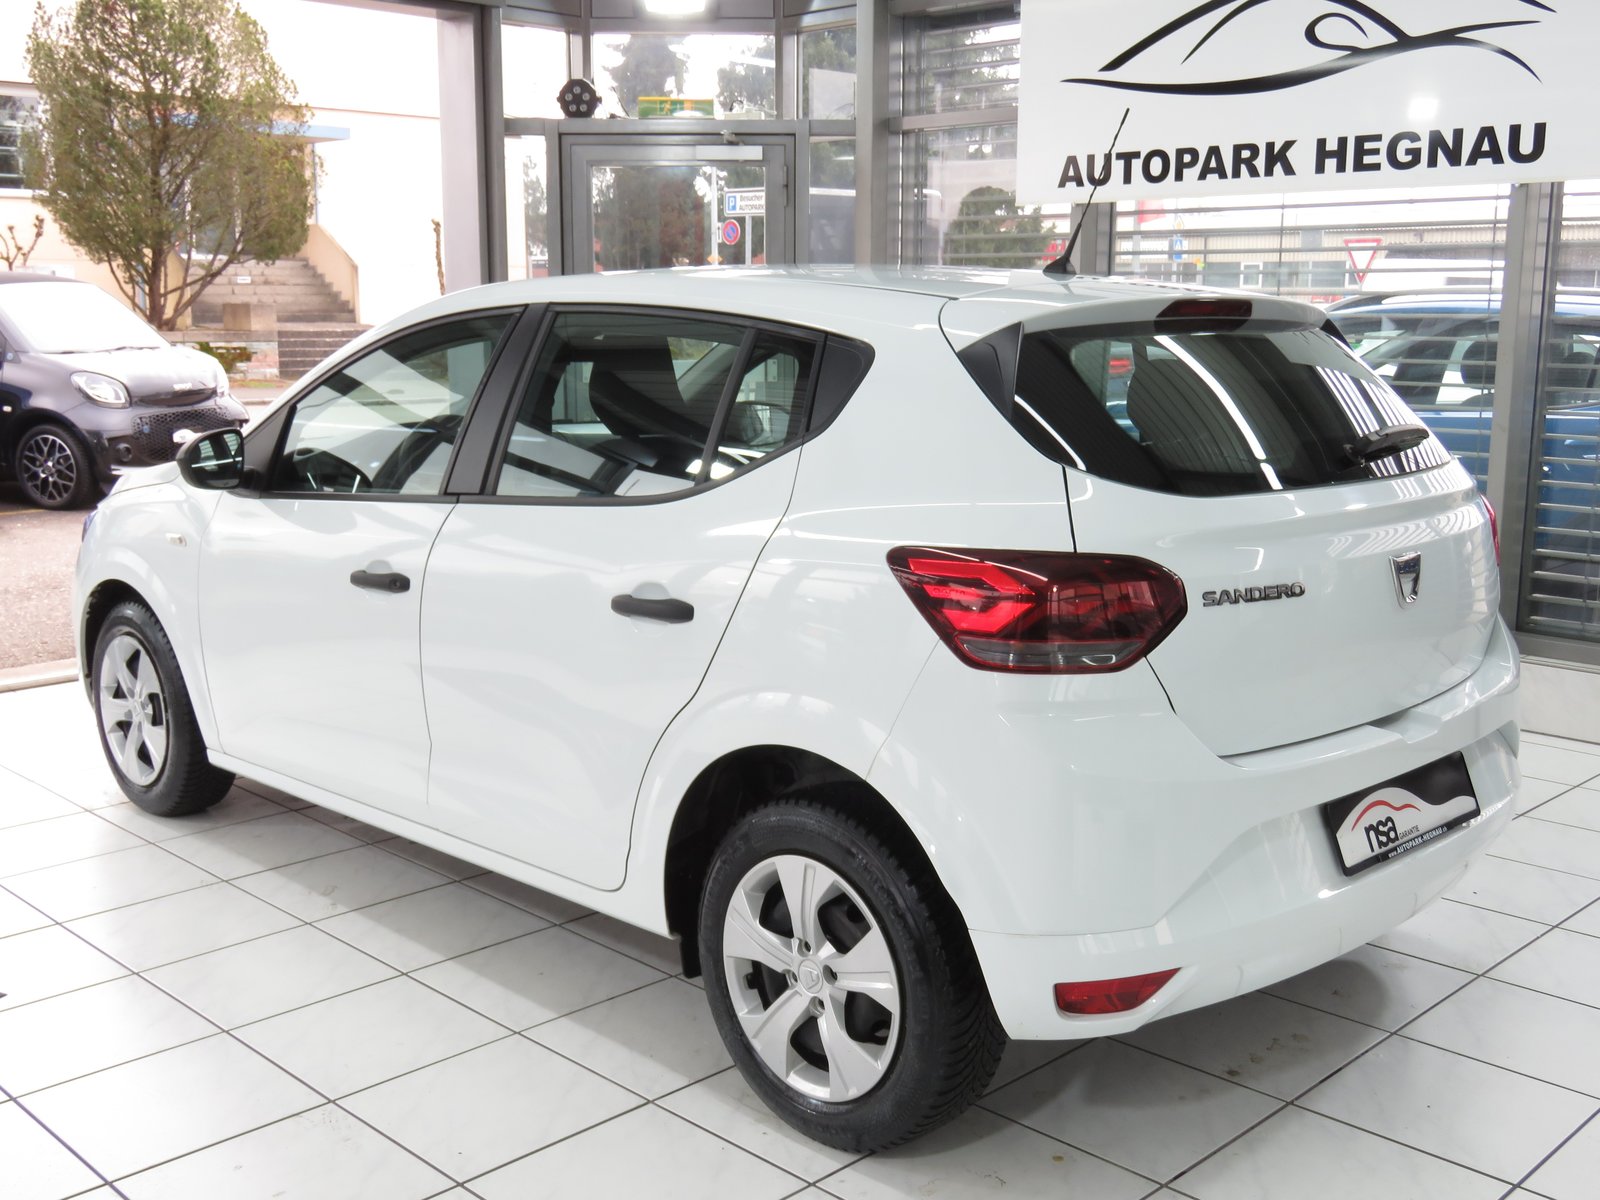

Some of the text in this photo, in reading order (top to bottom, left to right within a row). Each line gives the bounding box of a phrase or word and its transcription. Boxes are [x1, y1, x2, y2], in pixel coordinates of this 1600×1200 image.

[1058, 122, 1547, 188] AUTOPARK HEGNAU
[1202, 581, 1306, 607] SANDERO
[1364, 816, 1399, 853] nsa
[1399, 825, 1420, 840] GARANTIE
